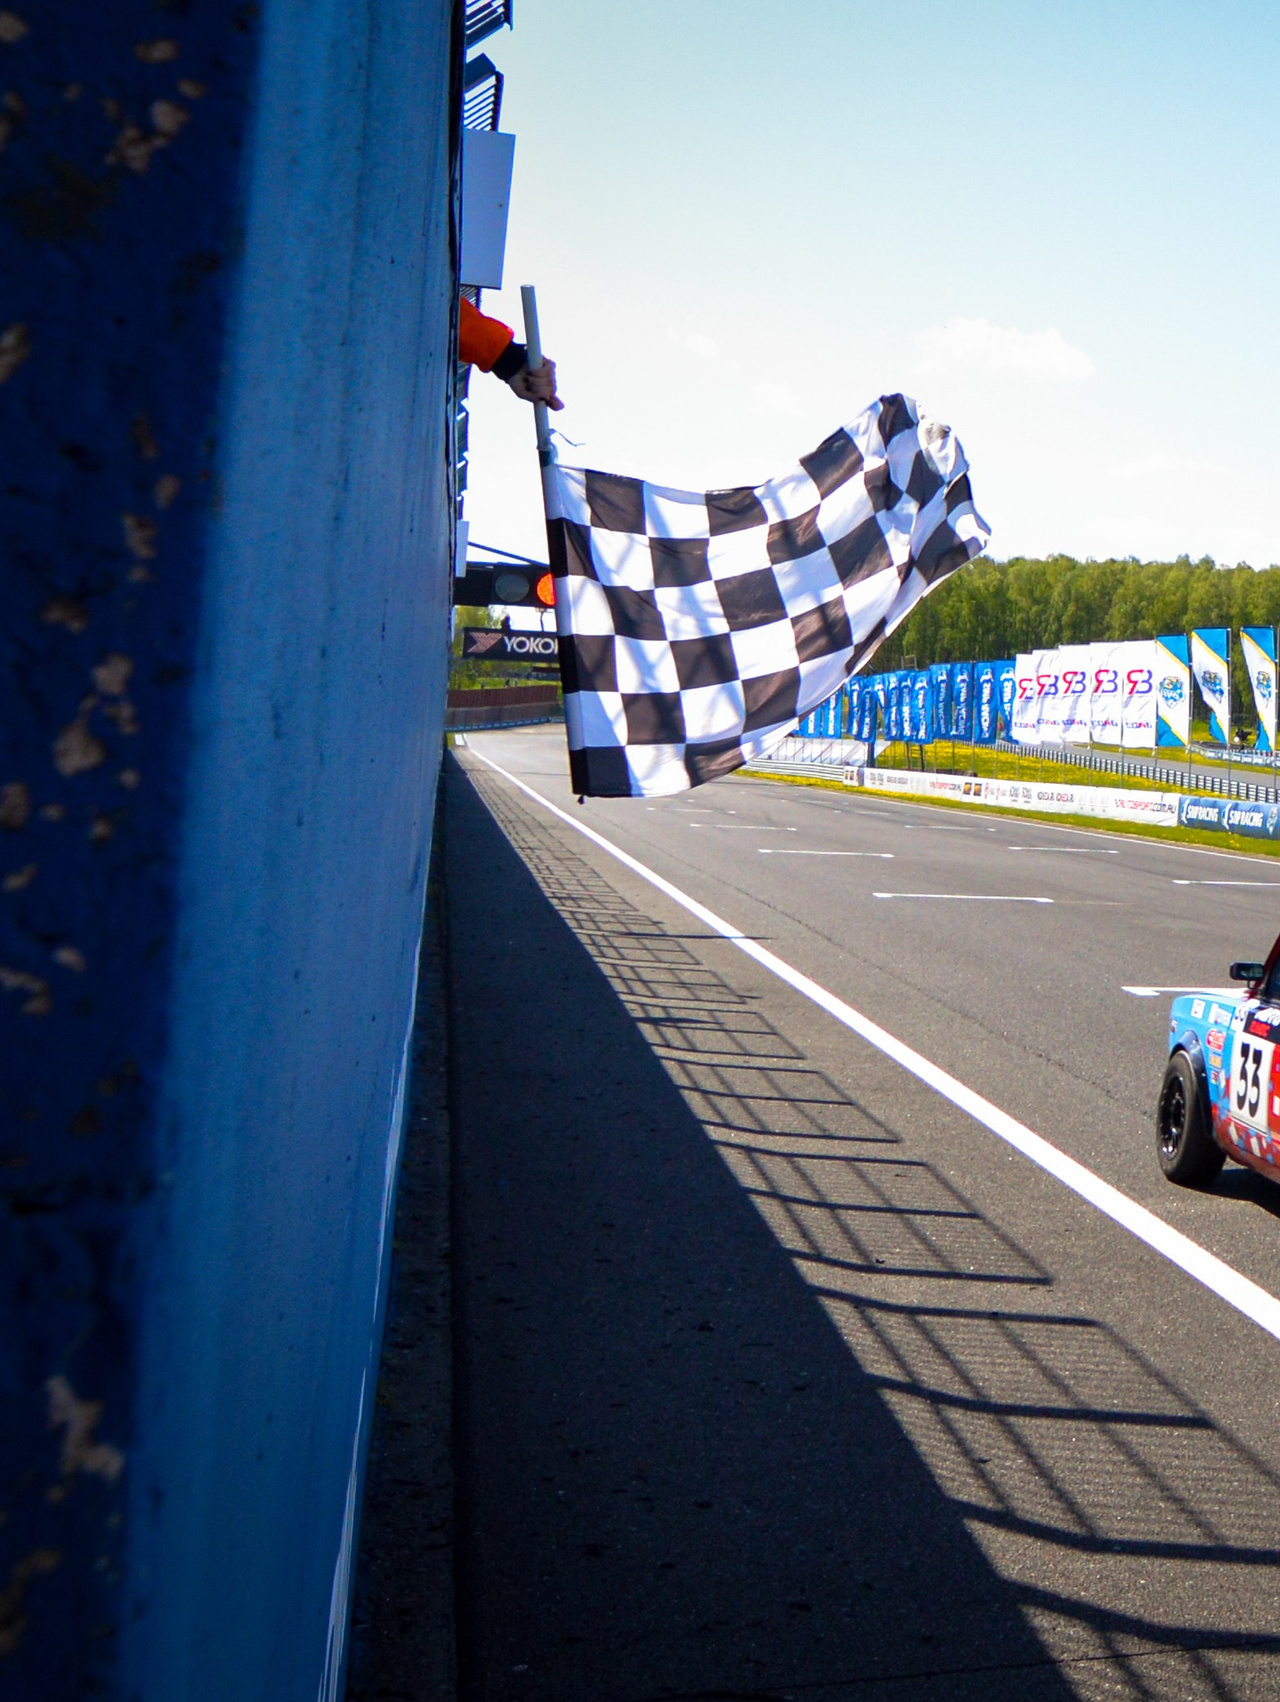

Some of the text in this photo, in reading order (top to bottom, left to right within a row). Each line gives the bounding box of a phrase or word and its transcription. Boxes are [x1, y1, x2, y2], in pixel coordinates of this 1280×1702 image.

[1187, 805, 1218, 822] SMP RACING
[1229, 809, 1264, 827] SMP RACING
[1237, 1041, 1264, 1118] 33
